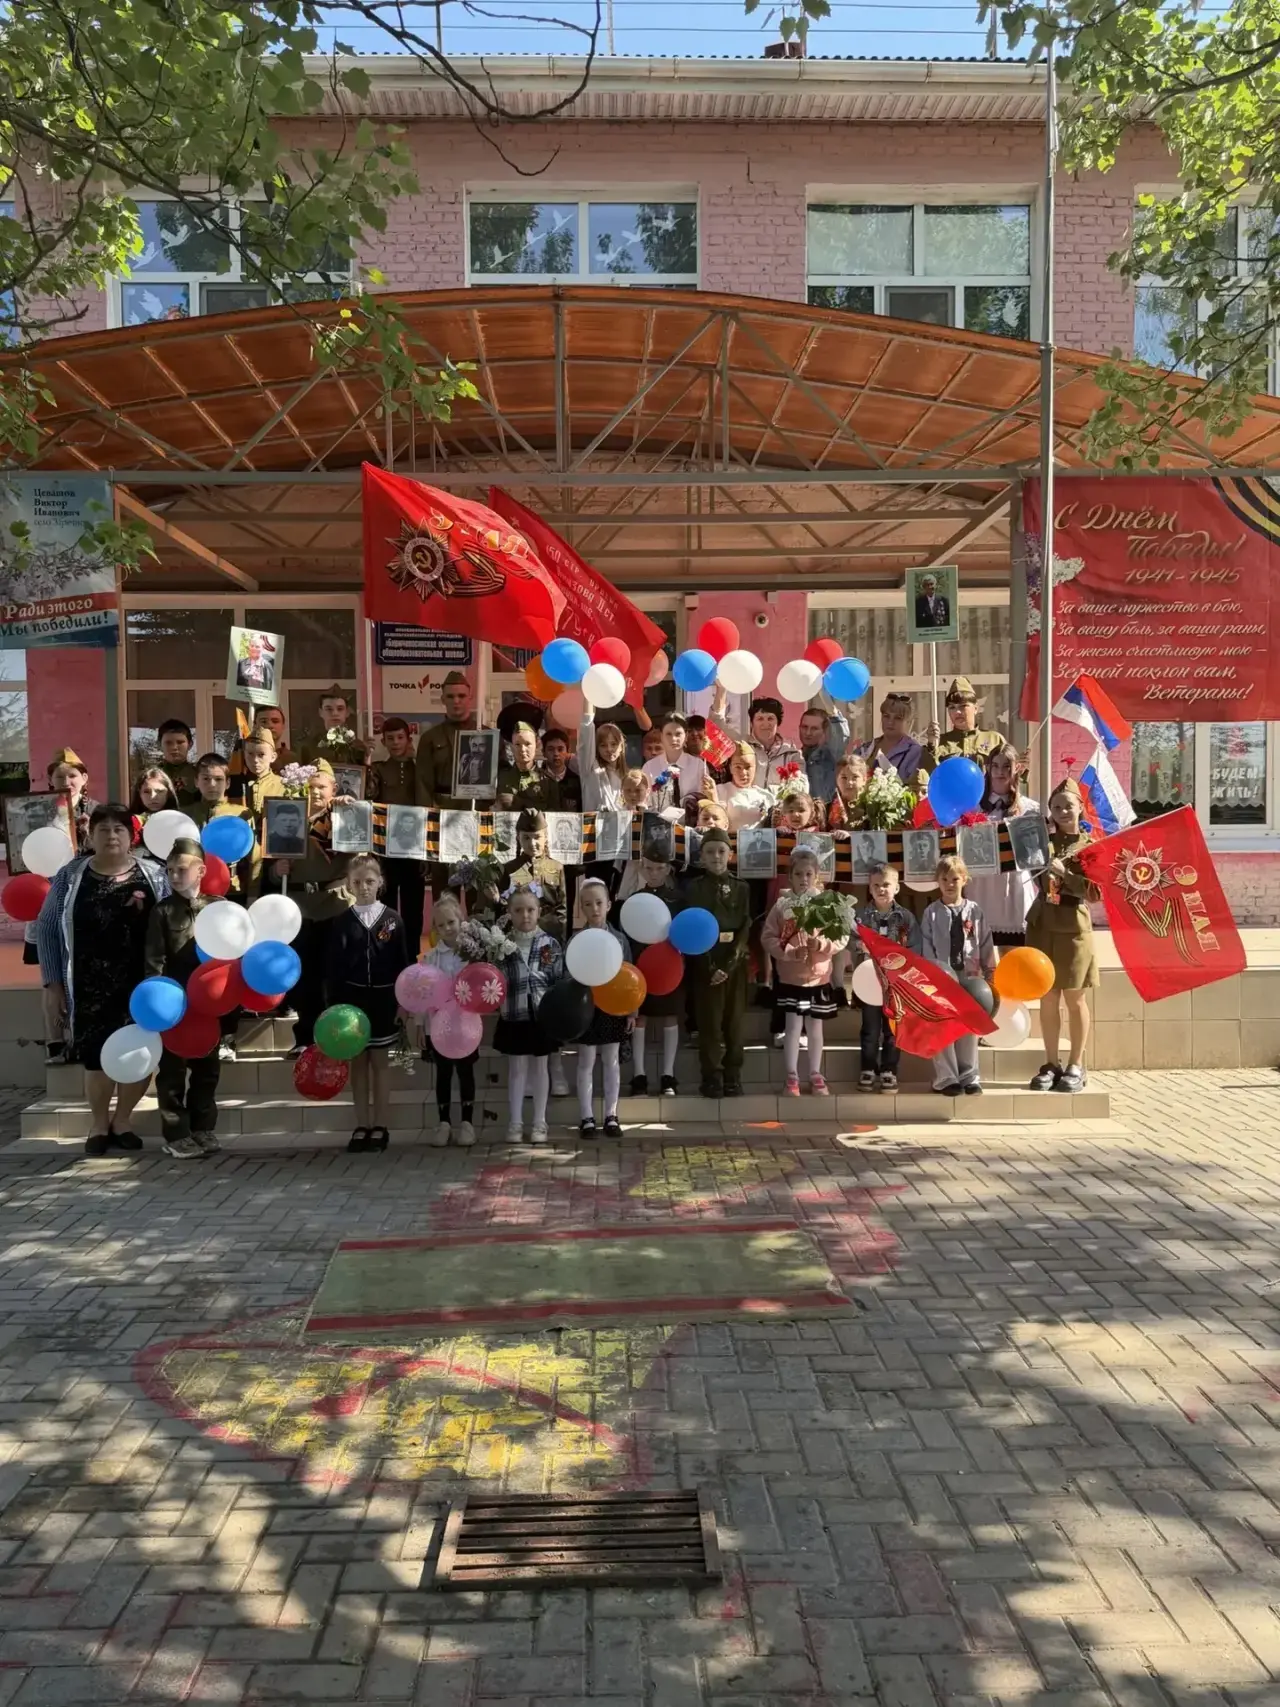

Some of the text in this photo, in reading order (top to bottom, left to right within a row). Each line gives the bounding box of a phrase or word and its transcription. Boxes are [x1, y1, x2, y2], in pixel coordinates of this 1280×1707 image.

[34, 498, 68, 509] Виктор
[34, 508, 80, 516] Иванович
[1054, 501, 1178, 532] С Днём
[1127, 531, 1247, 560] Победы!
[5, 598, 93, 619] Ради этого
[1056, 598, 1243, 617] За ваше мужество в бою,
[0, 611, 109, 636] Мы победили!
[1056, 620, 1266, 639] За вашу боль, за ваши раны,
[1055, 644, 1074, 657] За
[1076, 647, 1123, 657] жизнь
[1126, 644, 1217, 660] счастливую
[1219, 646, 1253, 656] мою
[1125, 666, 1190, 679] поклон
[1193, 666, 1237, 679] вам,
[1143, 683, 1254, 705] Ветераны!
[1212, 767, 1259, 780] БУДЕМ
[1212, 785, 1258, 799] ЖИТЬ!
[1173, 865, 1221, 952] 9 МАЯ
[880, 952, 907, 971] 9
